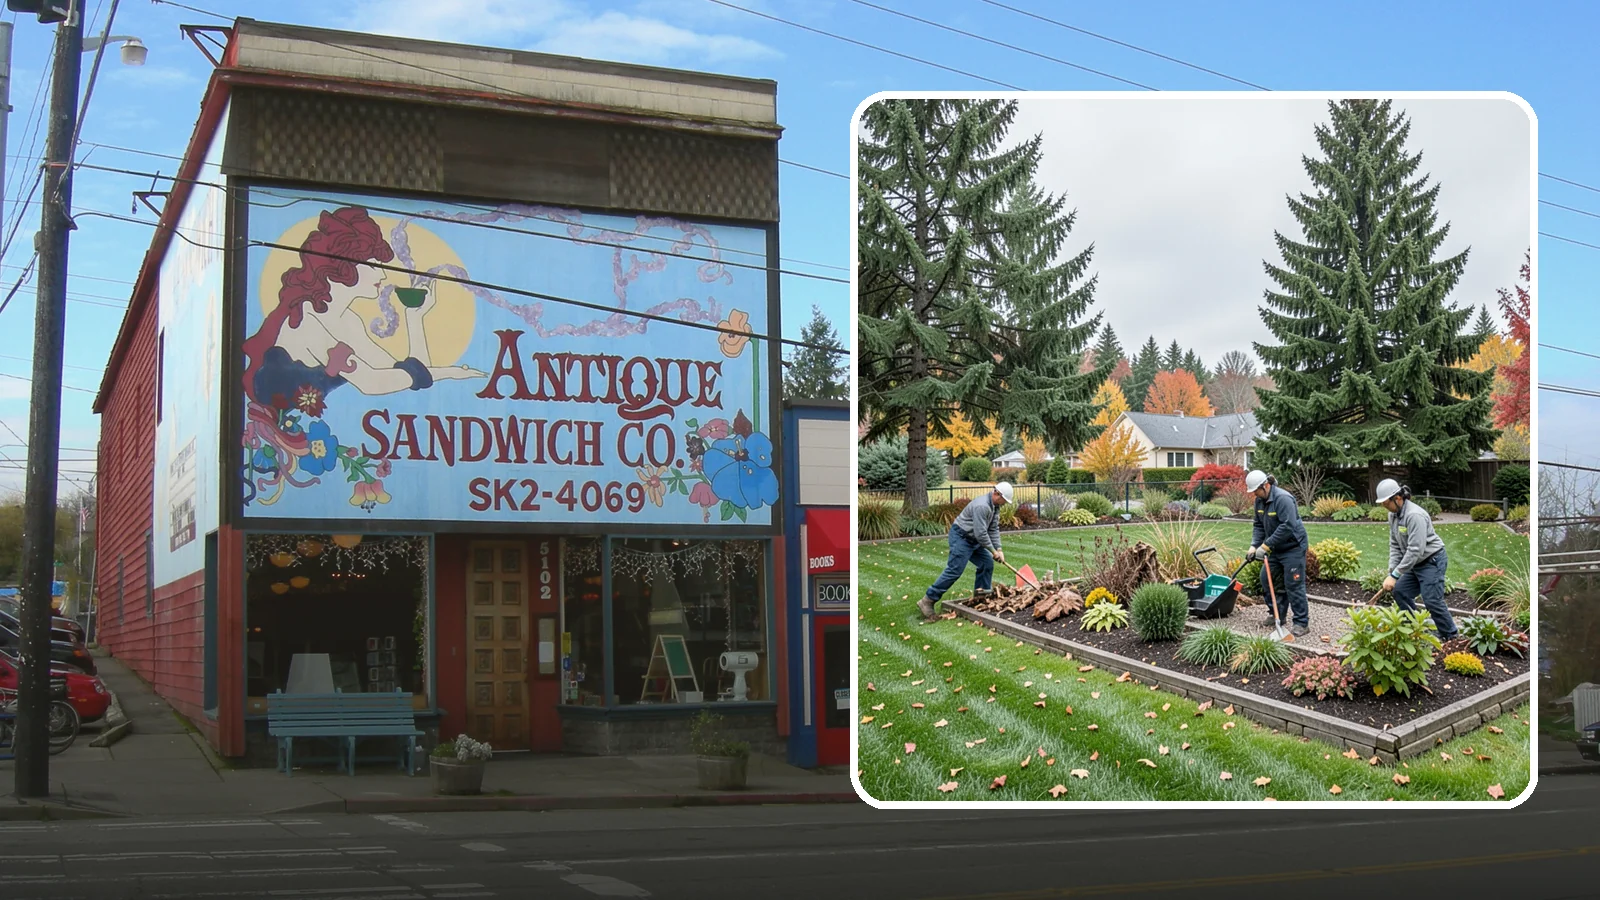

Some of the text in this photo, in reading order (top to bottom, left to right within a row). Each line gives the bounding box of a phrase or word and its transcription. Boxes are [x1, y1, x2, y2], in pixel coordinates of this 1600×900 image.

[476, 329, 724, 420] ANTIQUE
[361, 409, 685, 469] SANDWICH CO.
[468, 477, 646, 512] SK2-4069
[540, 542, 551, 599] 5102
[809, 555, 834, 568] BOOKS
